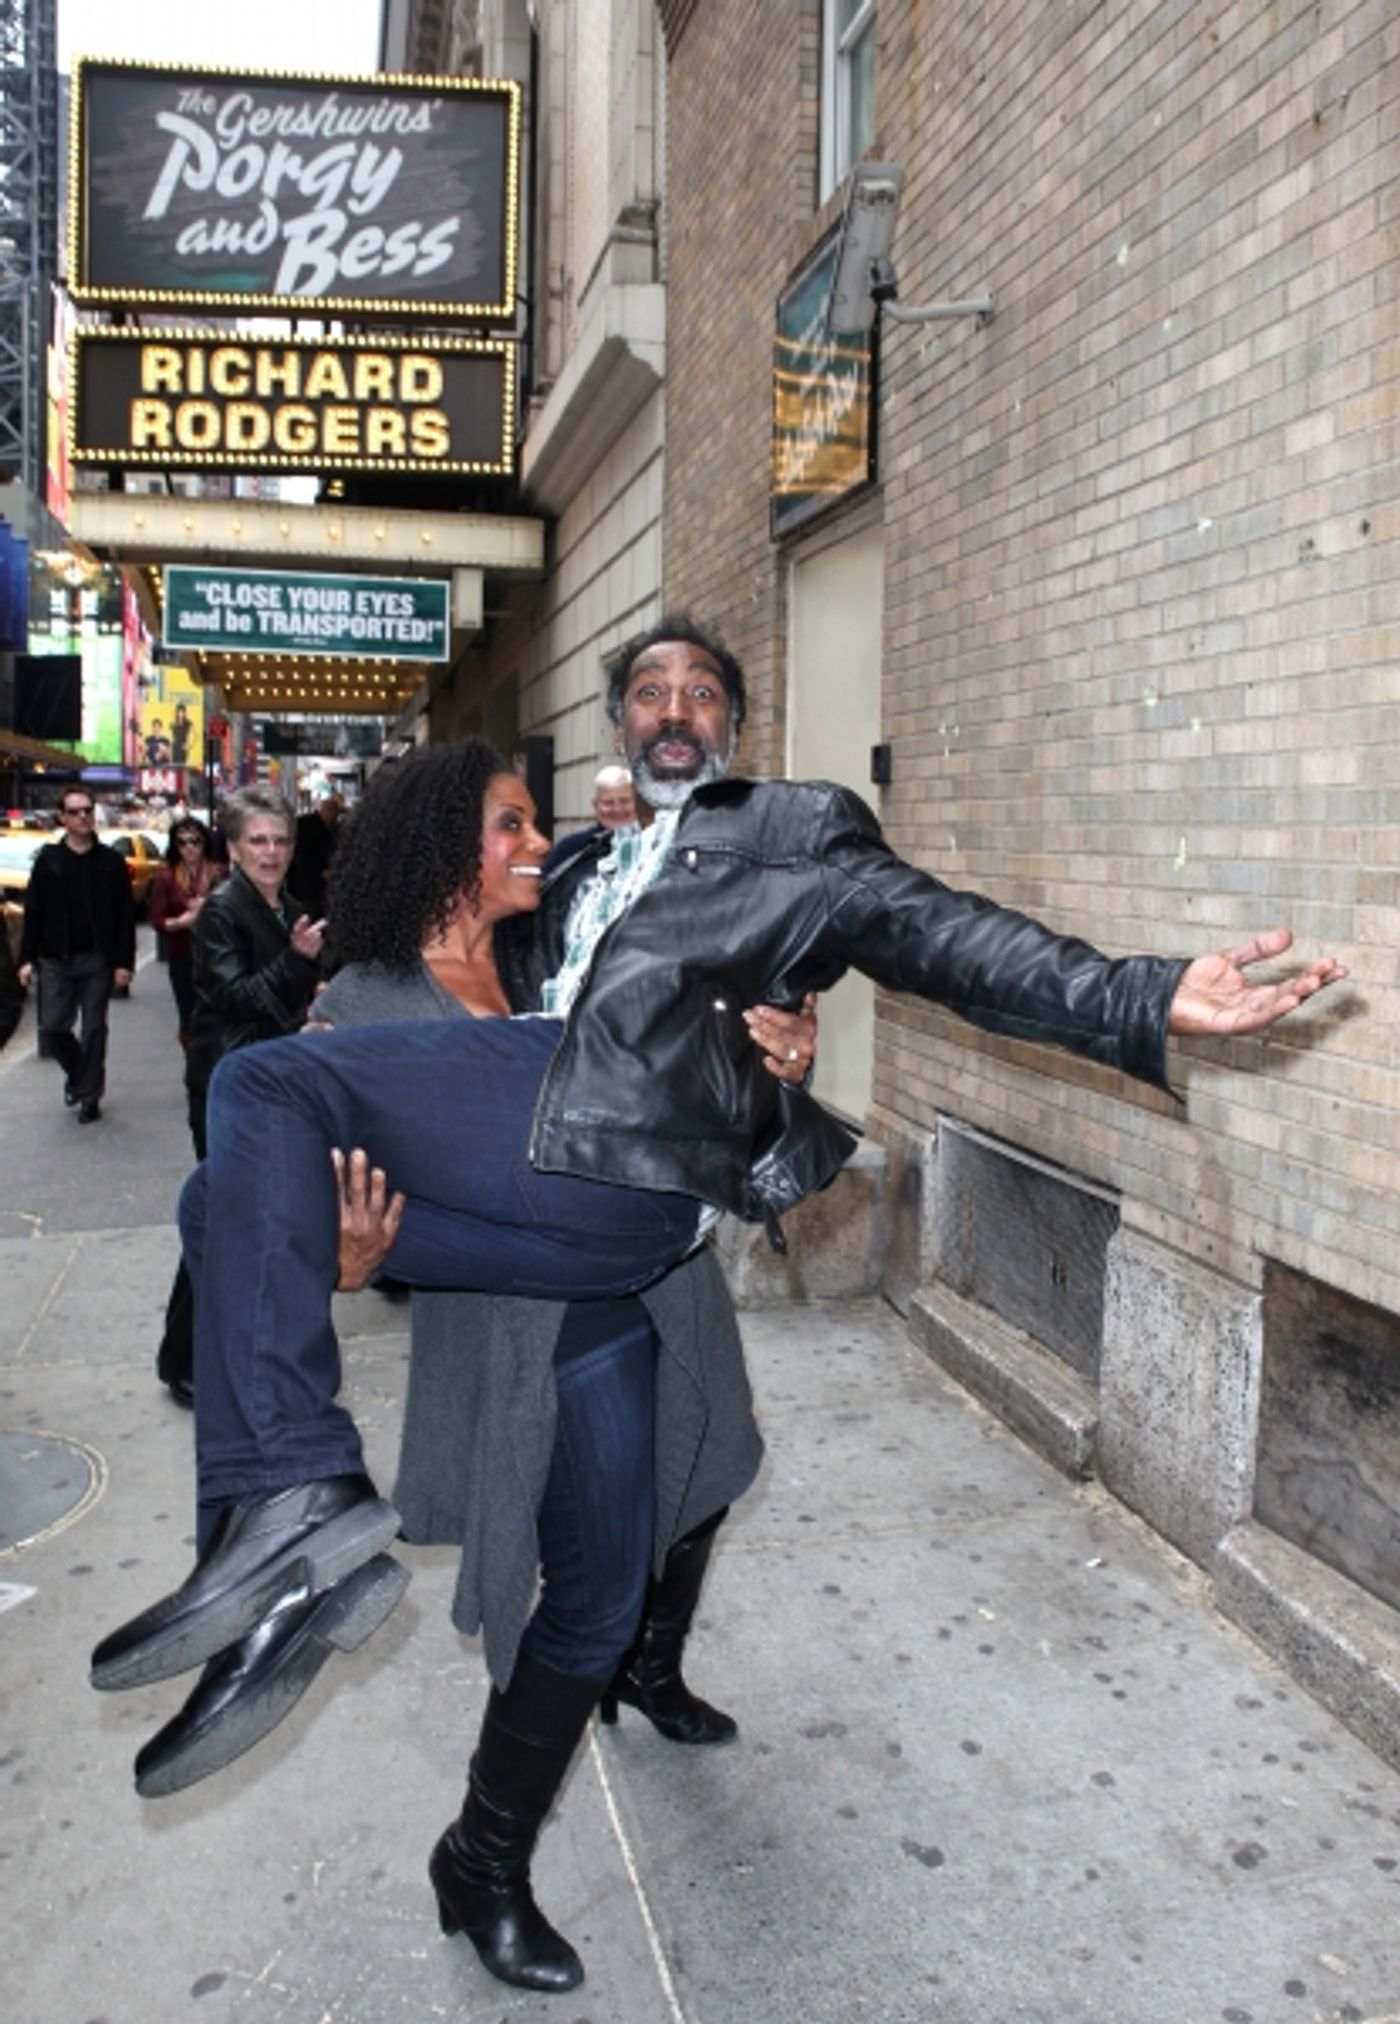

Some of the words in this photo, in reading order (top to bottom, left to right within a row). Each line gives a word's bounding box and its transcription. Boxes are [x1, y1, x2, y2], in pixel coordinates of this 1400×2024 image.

[177, 89, 217, 115] The
[216, 93, 442, 149] Gershwins'
[143, 111, 403, 219] Porgy
[177, 200, 278, 255] and
[274, 209, 460, 296] Bess
[142, 345, 443, 402] RICHARD
[131, 399, 450, 456] RODGERS
[179, 609, 220, 631] and
[226, 609, 251, 632] be
[257, 611, 444, 642] TRANSPORTED!"
[195, 581, 282, 607] "CLOSE
[288, 587, 351, 612] YOUR
[355, 592, 415, 616] EYES
